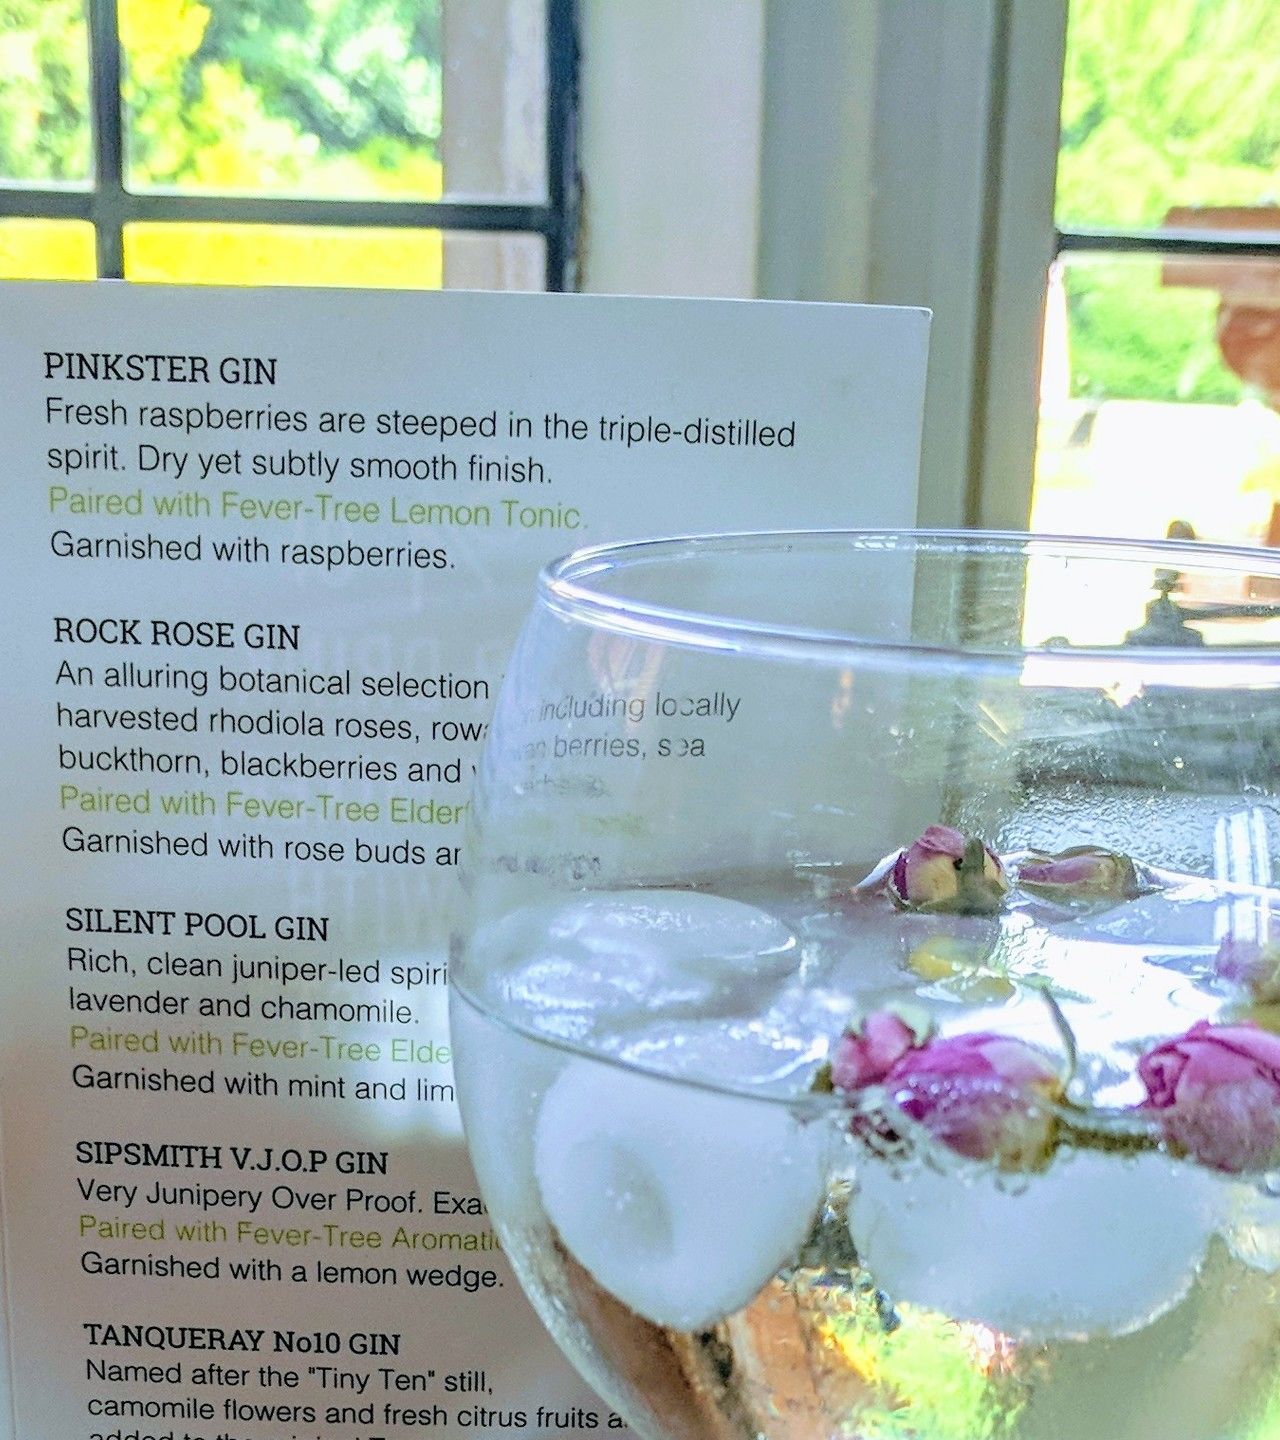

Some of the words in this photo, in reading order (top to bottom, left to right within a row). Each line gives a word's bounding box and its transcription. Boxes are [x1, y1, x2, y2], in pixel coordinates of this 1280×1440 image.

[43, 351, 211, 383] PINKSTER
[219, 356, 277, 385] GIN
[46, 396, 127, 426] Fresh
[139, 402, 308, 435] raspberries
[319, 412, 365, 434] are
[377, 410, 497, 443] steeped
[509, 411, 532, 438] in
[544, 412, 589, 441] the
[599, 414, 796, 448] triple-distilled
[47, 446, 126, 476] spirit.
[138, 444, 189, 479] Dry
[198, 449, 242, 480] yet
[252, 449, 340, 484] subtly
[350, 453, 457, 481] smooth
[468, 454, 551, 484] finish.
[48, 485, 143, 516] Paired
[153, 492, 211, 517] with
[221, 490, 380, 523] Fever-Tree
[391, 496, 491, 526] Lemon
[500, 499, 587, 530] Tonic.
[50, 530, 201, 561] Garnished
[212, 536, 269, 563] with
[281, 540, 454, 571] raspberries.
[53, 617, 142, 645] ROCK
[150, 620, 235, 649] ROSE
[243, 623, 300, 650] GIN
[55, 660, 94, 686] An
[104, 662, 208, 697] alluring
[219, 665, 350, 695] botanical
[362, 671, 489, 700] selection
[57, 701, 198, 732] harvested
[209, 707, 325, 737] rhodiola
[336, 718, 419, 744] roses,
[553, 733, 648, 761] berries,
[59, 743, 209, 778] buckthorn,
[221, 749, 397, 782] blackberries
[407, 758, 461, 784] and
[65, 907, 176, 936] SILENT
[184, 912, 267, 940] POOL
[275, 915, 330, 942] GIN
[69, 986, 190, 1015] lavender
[198, 994, 250, 1018] and
[261, 995, 419, 1025] chamomile.
[76, 1140, 223, 1170] SIPSMITH
[229, 1146, 328, 1173] V.J.O.P
[335, 1150, 389, 1175] GIN
[80, 1250, 220, 1279] Garnished
[229, 1258, 282, 1282] with
[290, 1265, 308, 1283] a
[317, 1260, 397, 1285] lemon
[406, 1264, 504, 1293] wedge.
[82, 1323, 266, 1352] TANQUERAY
[272, 1330, 341, 1355] No10
[348, 1332, 402, 1356] GIN
[86, 1358, 182, 1384] Named
[191, 1363, 250, 1387] after
[258, 1365, 300, 1388] the
[307, 1366, 371, 1395] "Tiny
[378, 1368, 435, 1392] Ten"
[444, 1370, 493, 1396] still,
[87, 1397, 215, 1421] camomile
[223, 1398, 316, 1423] flowers
[325, 1403, 374, 1425] and
[383, 1403, 447, 1426] fresh
[457, 1405, 527, 1428] citrus
[536, 1406, 599, 1429] fruits
